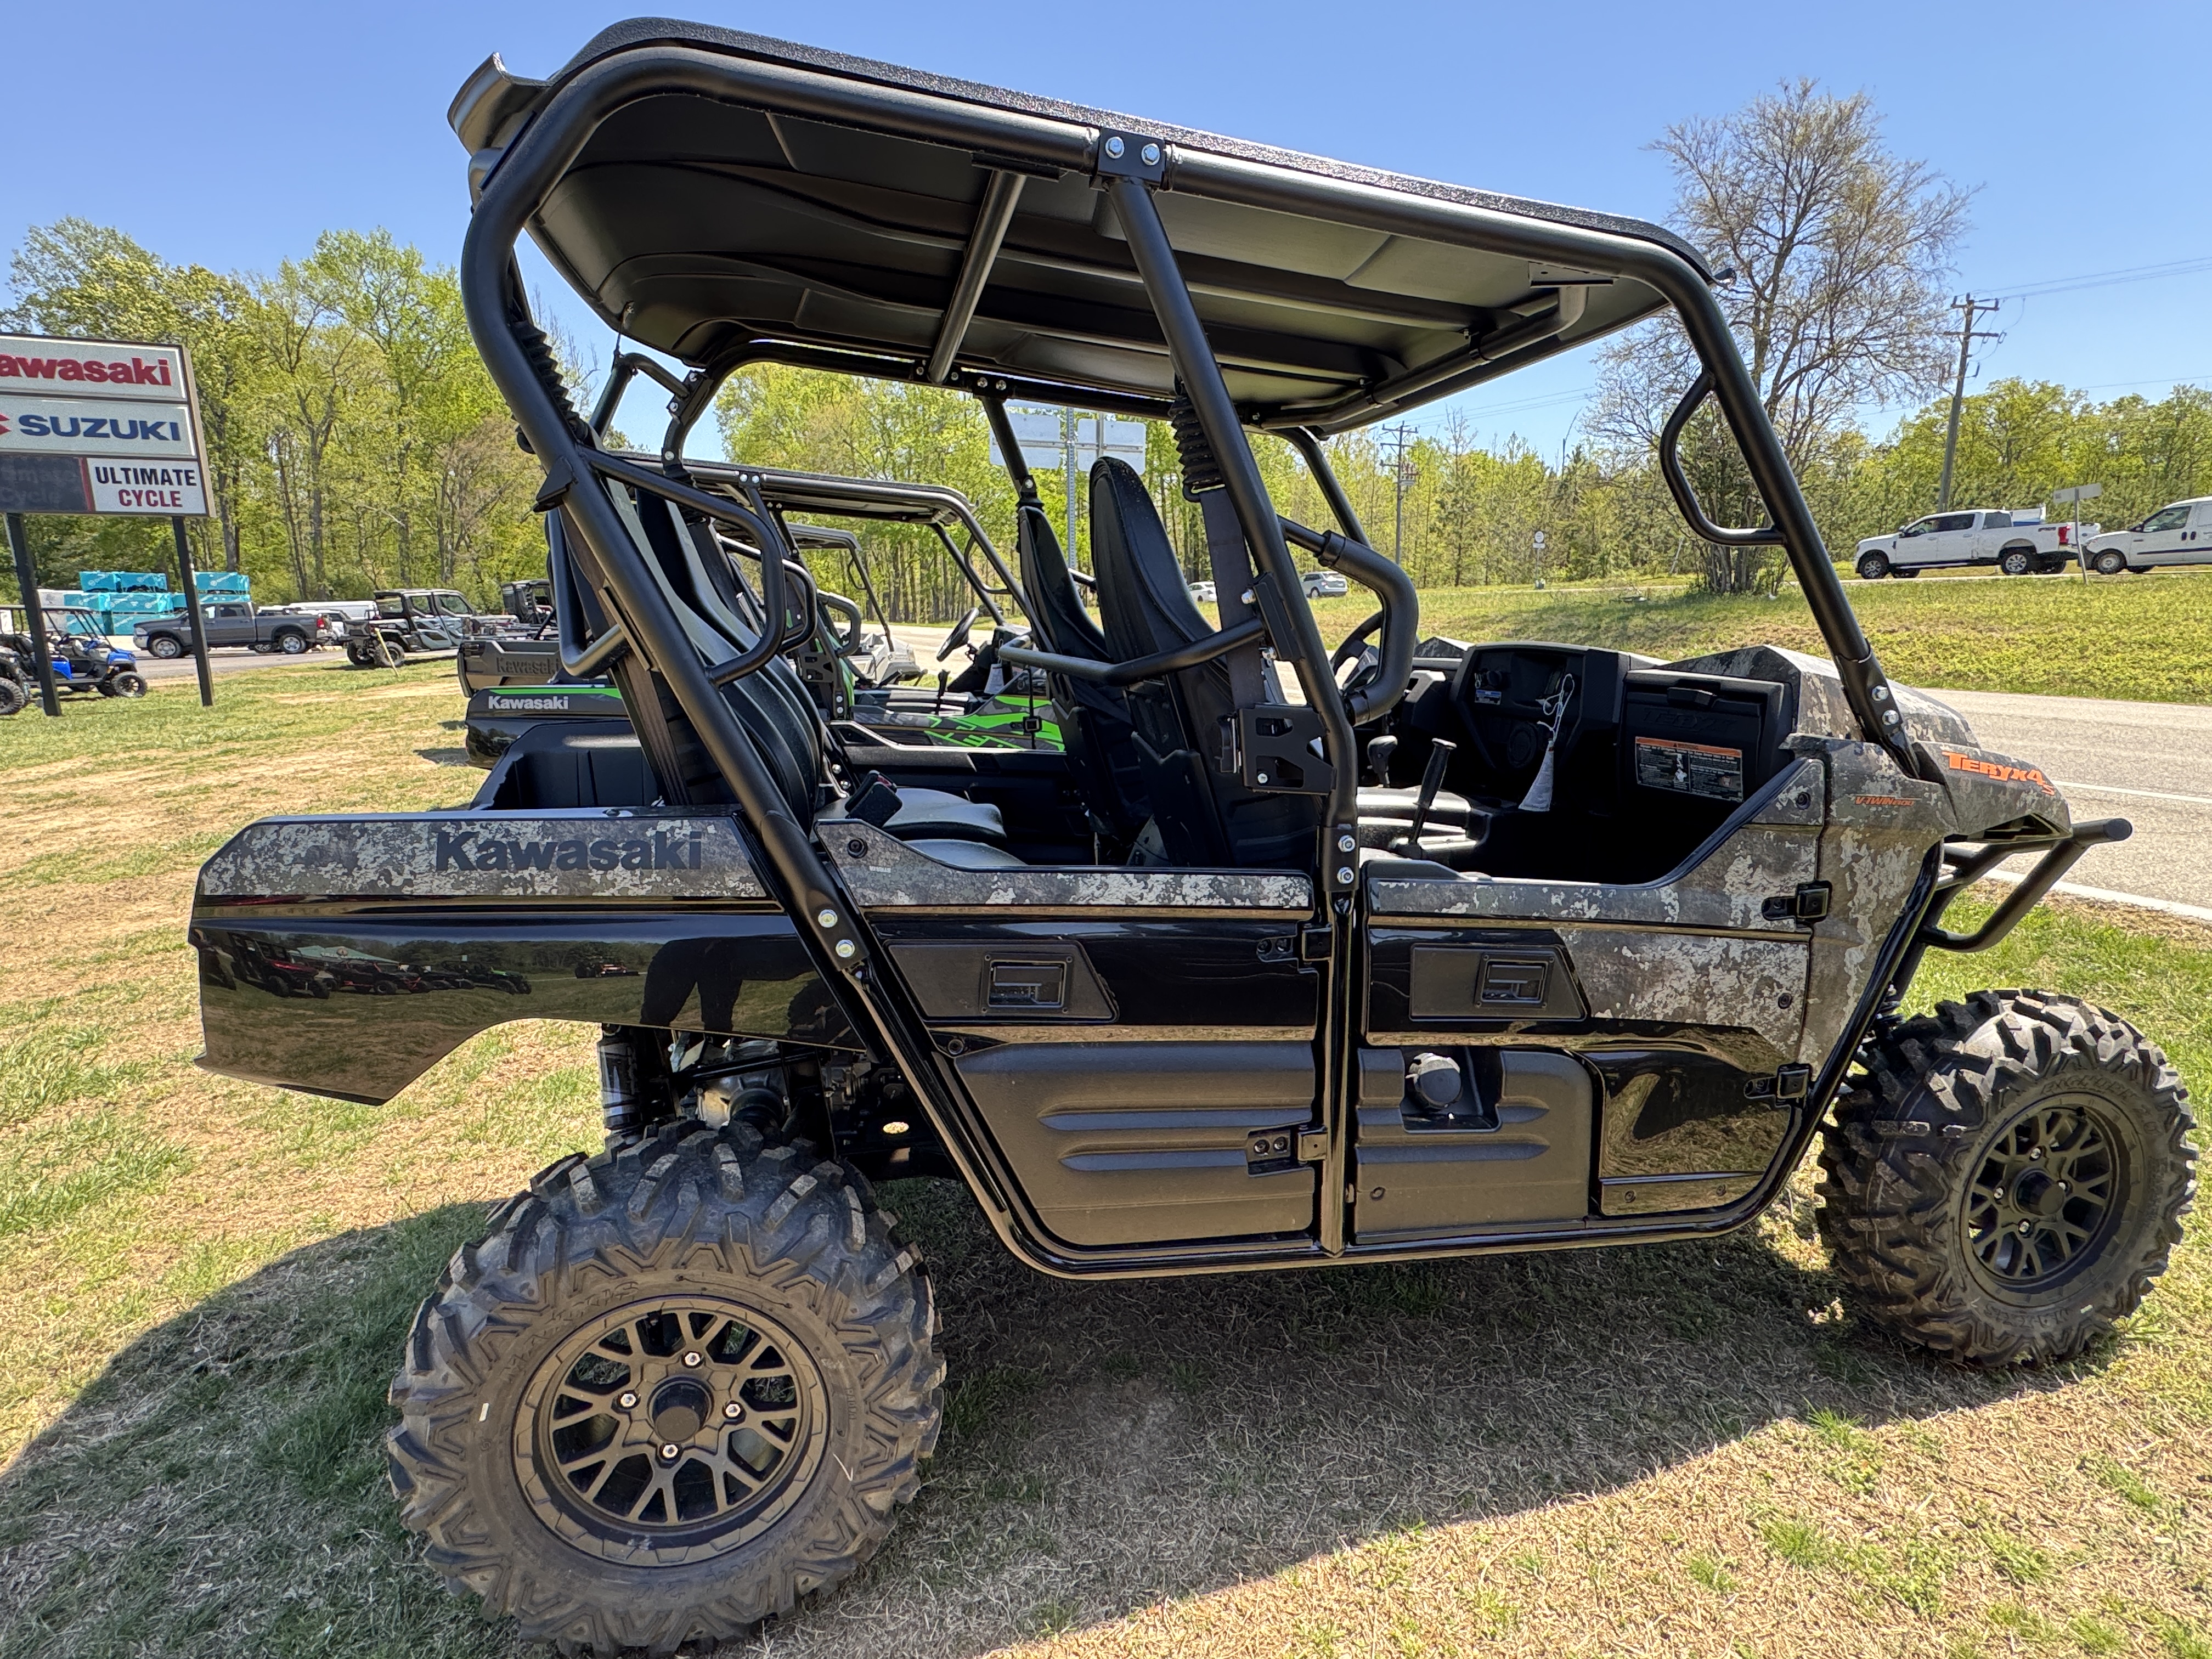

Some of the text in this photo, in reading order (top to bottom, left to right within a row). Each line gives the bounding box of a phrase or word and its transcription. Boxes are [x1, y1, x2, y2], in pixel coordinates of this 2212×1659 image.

[0, 354, 172, 386] awasaki
[18, 414, 182, 441] SUZUKI
[95, 466, 197, 487] ULTIMATE
[118, 489, 183, 508] CYCLE
[488, 696, 569, 710] Kawasaki
[436, 831, 702, 871] Kawasaki
